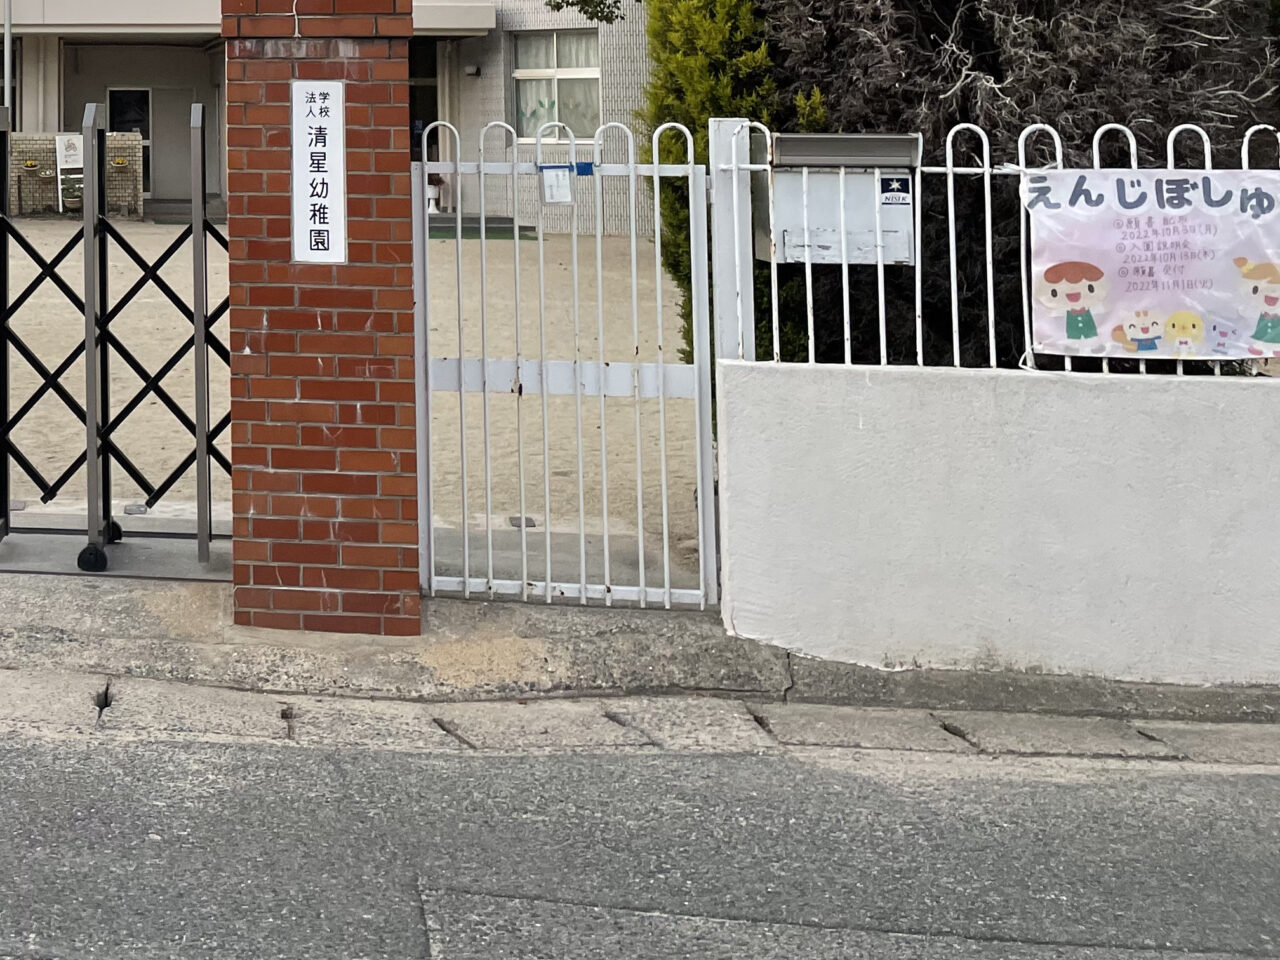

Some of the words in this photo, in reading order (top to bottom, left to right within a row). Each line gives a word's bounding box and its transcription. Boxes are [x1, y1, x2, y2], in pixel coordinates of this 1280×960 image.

[305, 91, 317, 119] 法人
[318, 91, 331, 119] 学校
[307, 125, 330, 251] 清星幼稚園
